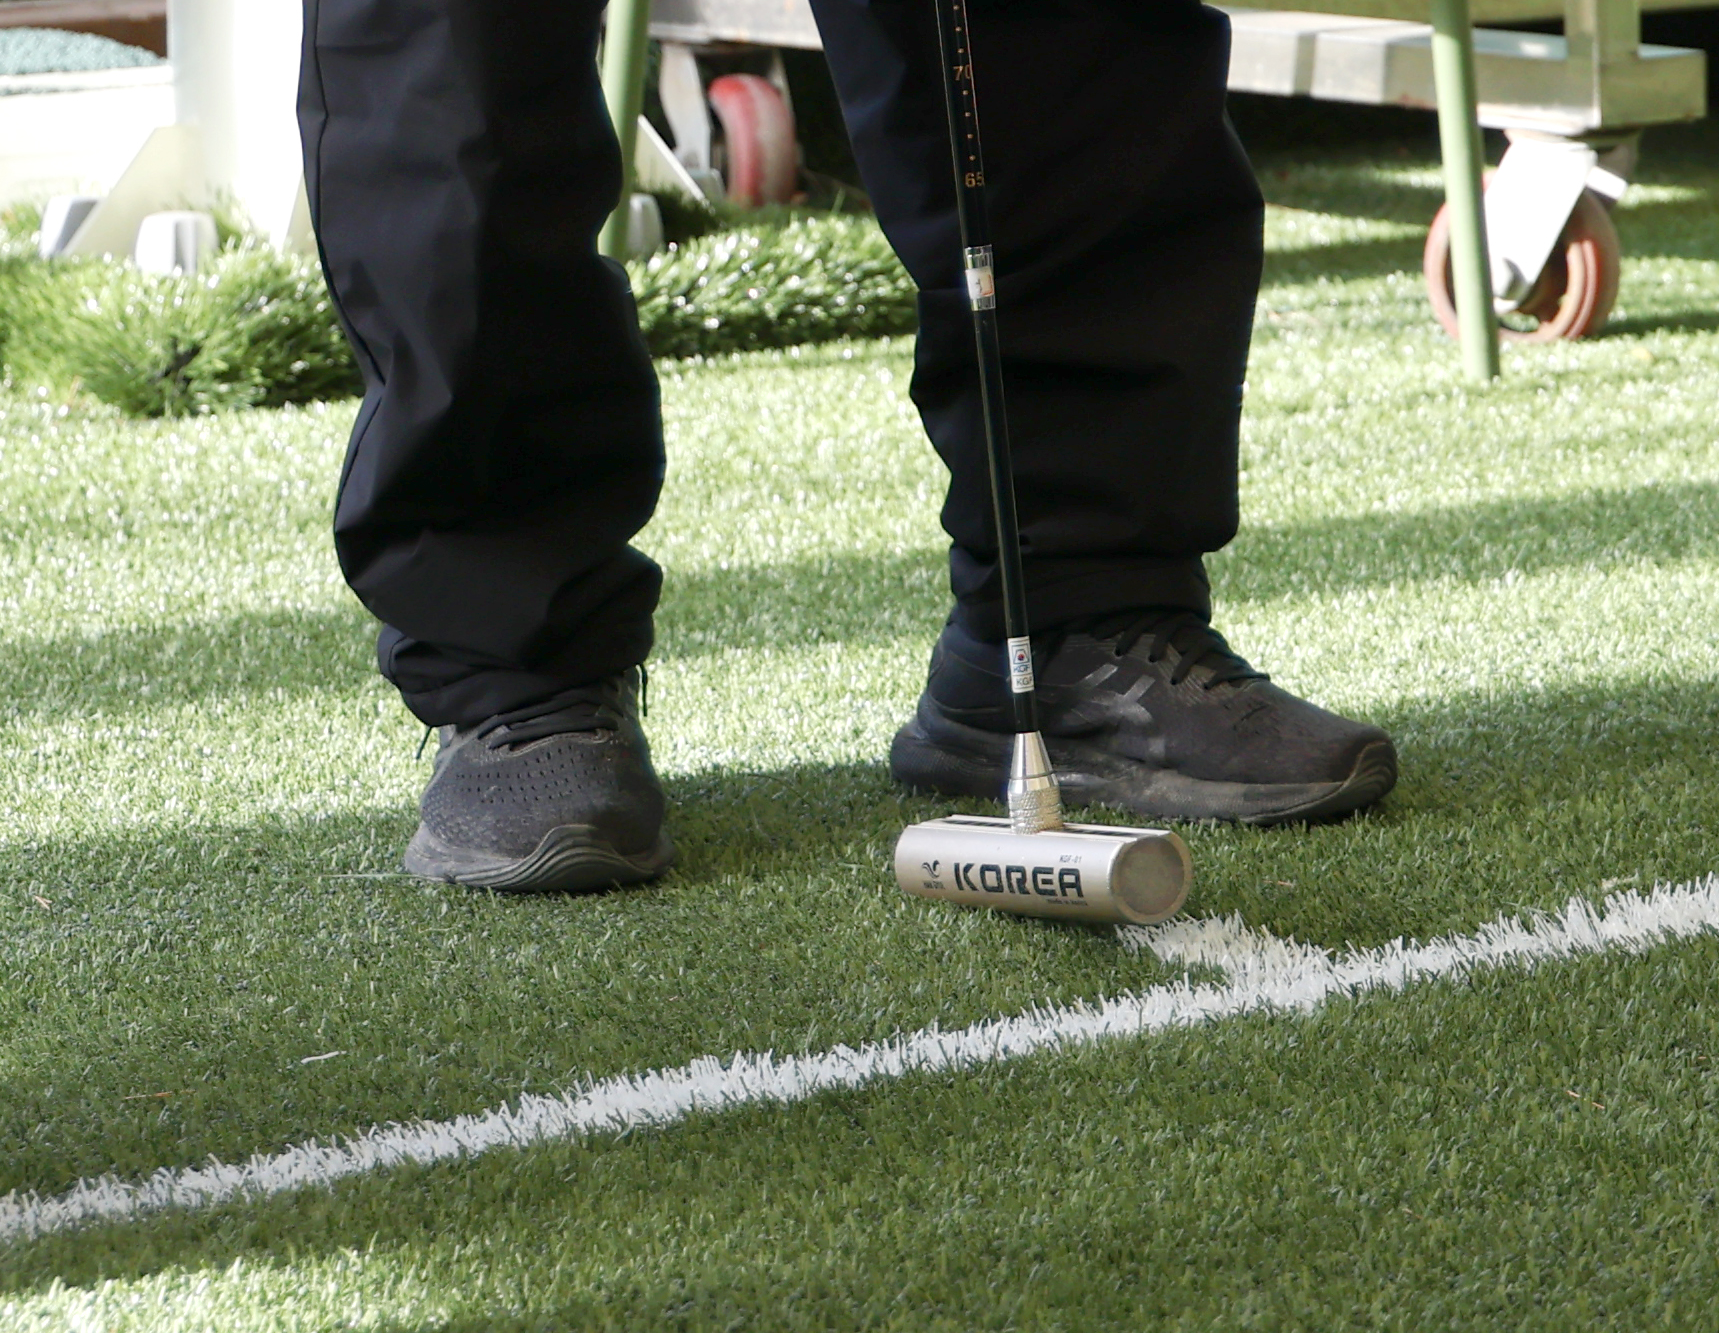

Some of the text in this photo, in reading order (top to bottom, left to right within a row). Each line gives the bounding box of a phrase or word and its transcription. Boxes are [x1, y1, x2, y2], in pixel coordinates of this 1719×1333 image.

[953, 64, 973, 81] 70
[964, 171, 985, 188] 65
[953, 862, 1085, 899] KOREA
